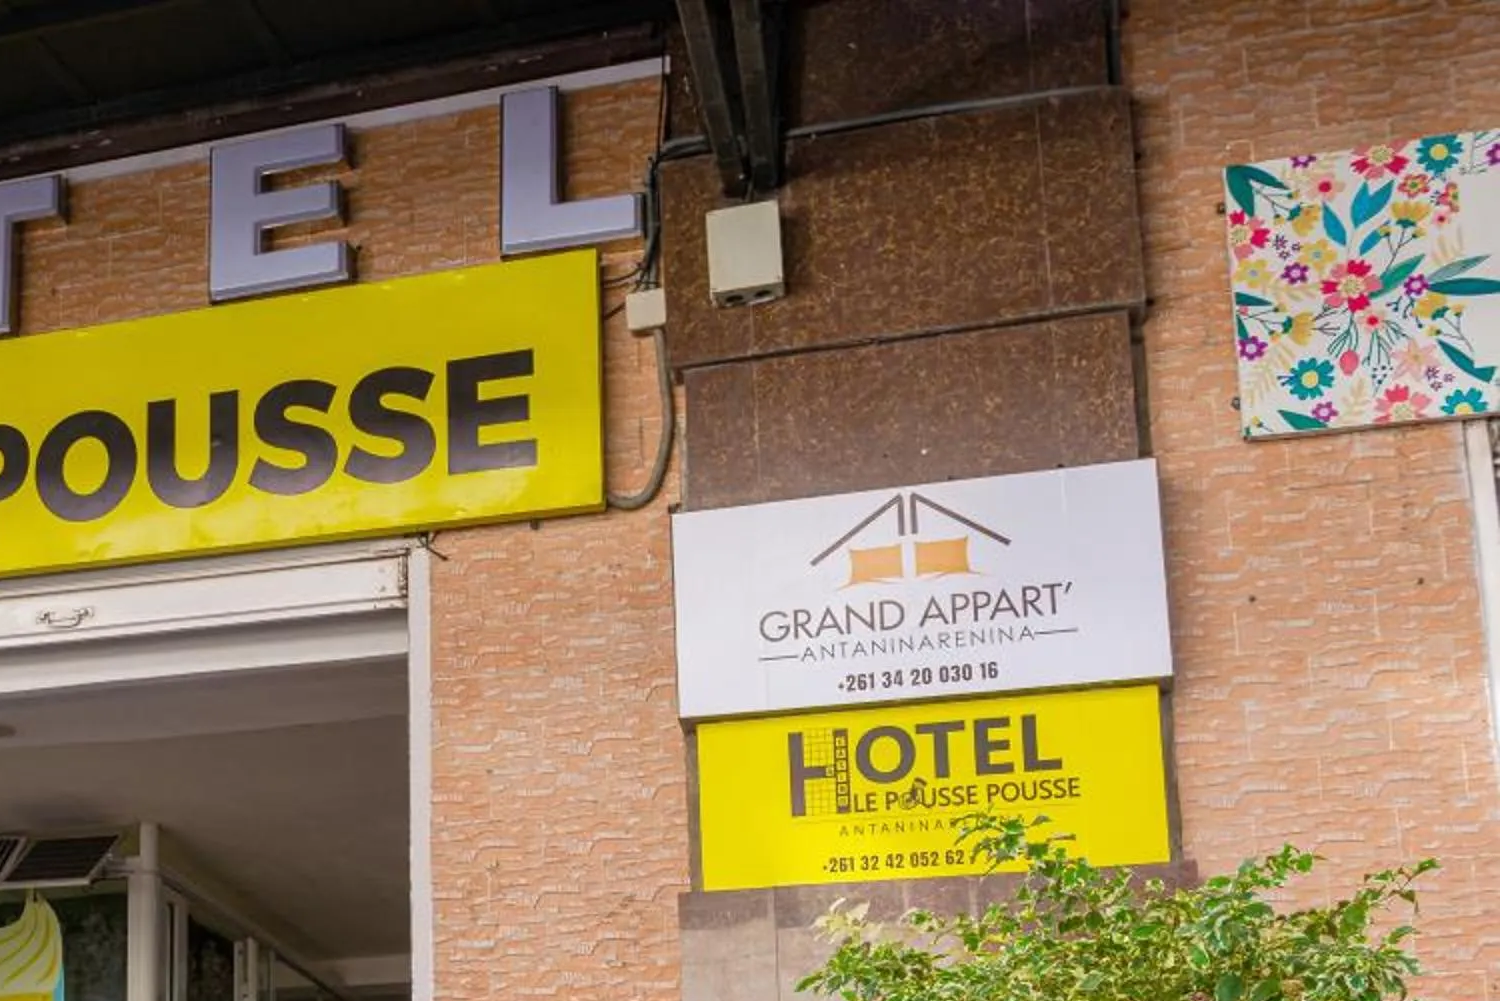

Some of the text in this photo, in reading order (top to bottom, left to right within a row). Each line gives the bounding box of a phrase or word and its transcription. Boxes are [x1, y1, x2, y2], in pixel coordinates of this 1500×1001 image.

[759, 599, 905, 643] GRAND
[801, 626, 1036, 662] ANTANINARENINA
[882, 670, 904, 690] 34
[911, 668, 933, 687] 20
[939, 664, 973, 684] 030
[980, 661, 999, 680] 16
[787, 713, 1063, 817] HOTEL
[854, 791, 878, 814] LE
[987, 777, 1082, 804] POUSSE
[861, 853, 880, 872] 32
[885, 852, 906, 870] 42
[910, 851, 941, 869] 052
[945, 849, 966, 866] 62
